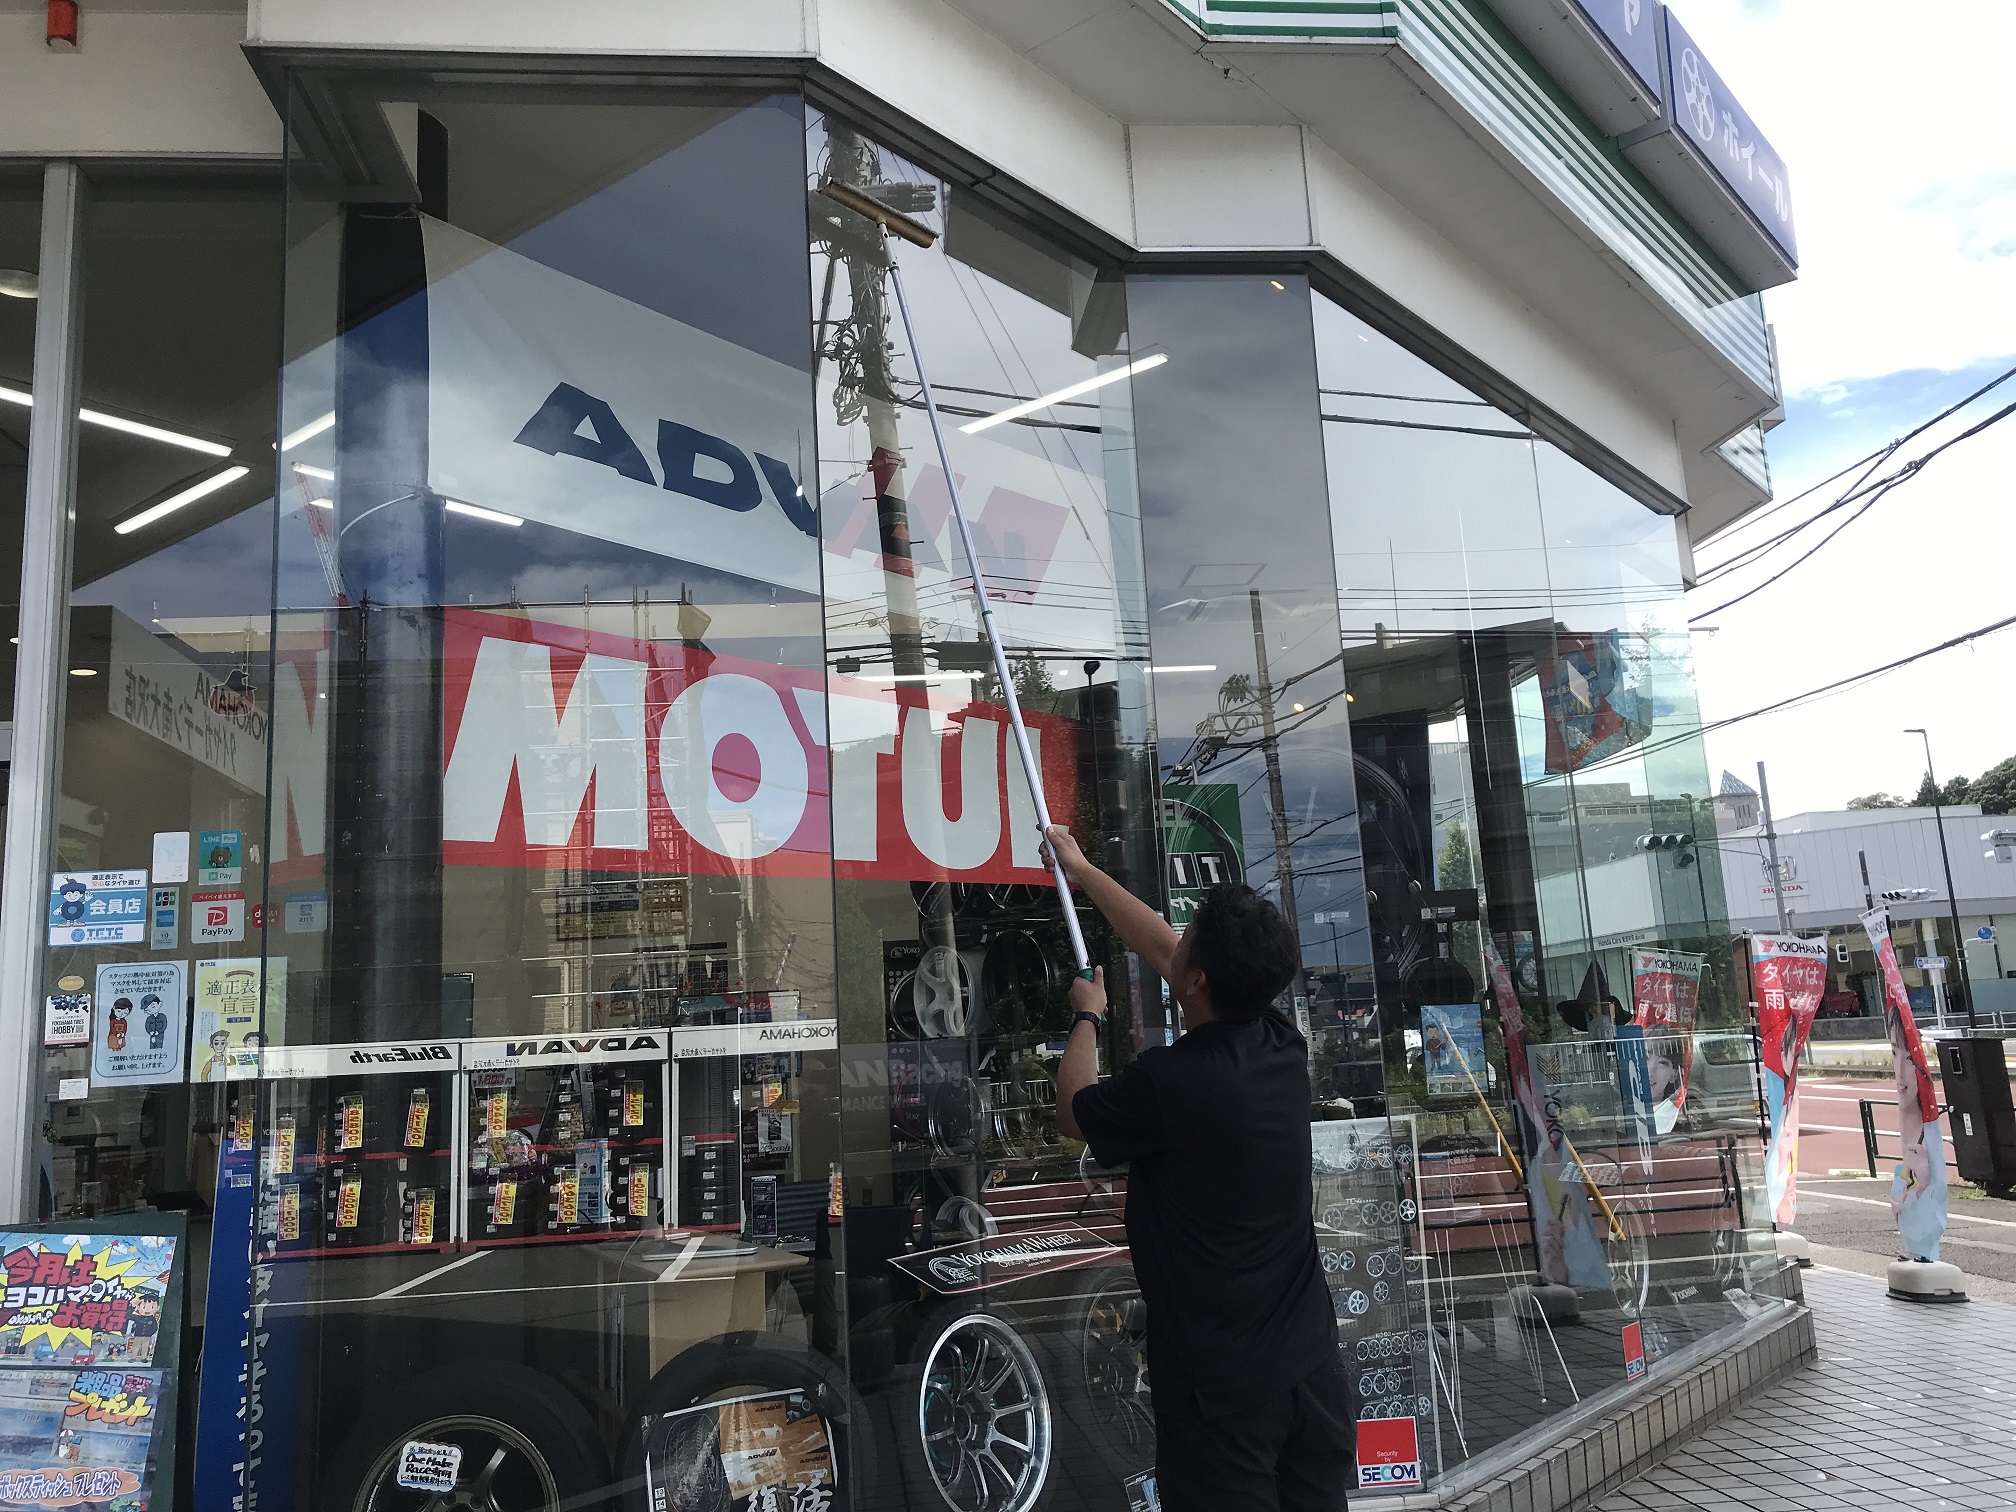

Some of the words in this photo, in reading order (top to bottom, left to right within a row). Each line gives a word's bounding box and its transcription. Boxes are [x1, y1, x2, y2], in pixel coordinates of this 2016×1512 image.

[1721, 109, 1788, 223] ホイール
[203, 835, 220, 843] LINE
[219, 872, 232, 880] Pay
[89, 897, 142, 916] 会員店
[201, 927, 234, 937] PayPay
[1776, 940, 1827, 955] YOKOHAMA
[1654, 958, 1698, 973] YOKOHAMA
[1762, 962, 1824, 986] タイヤは、
[220, 995, 258, 1015] 宣言
[53, 1025, 76, 1035] HOBBY
[3, 1245, 98, 1286] 今月は
[74, 1371, 125, 1398] 粗品
[64, 1388, 152, 1427] プレゼント
[426, 1456, 454, 1469] Make
[1376, 1450, 1399, 1458] Security
[1361, 1463, 1417, 1483] SECOM
[73, 1470, 122, 1496] プレゼント
